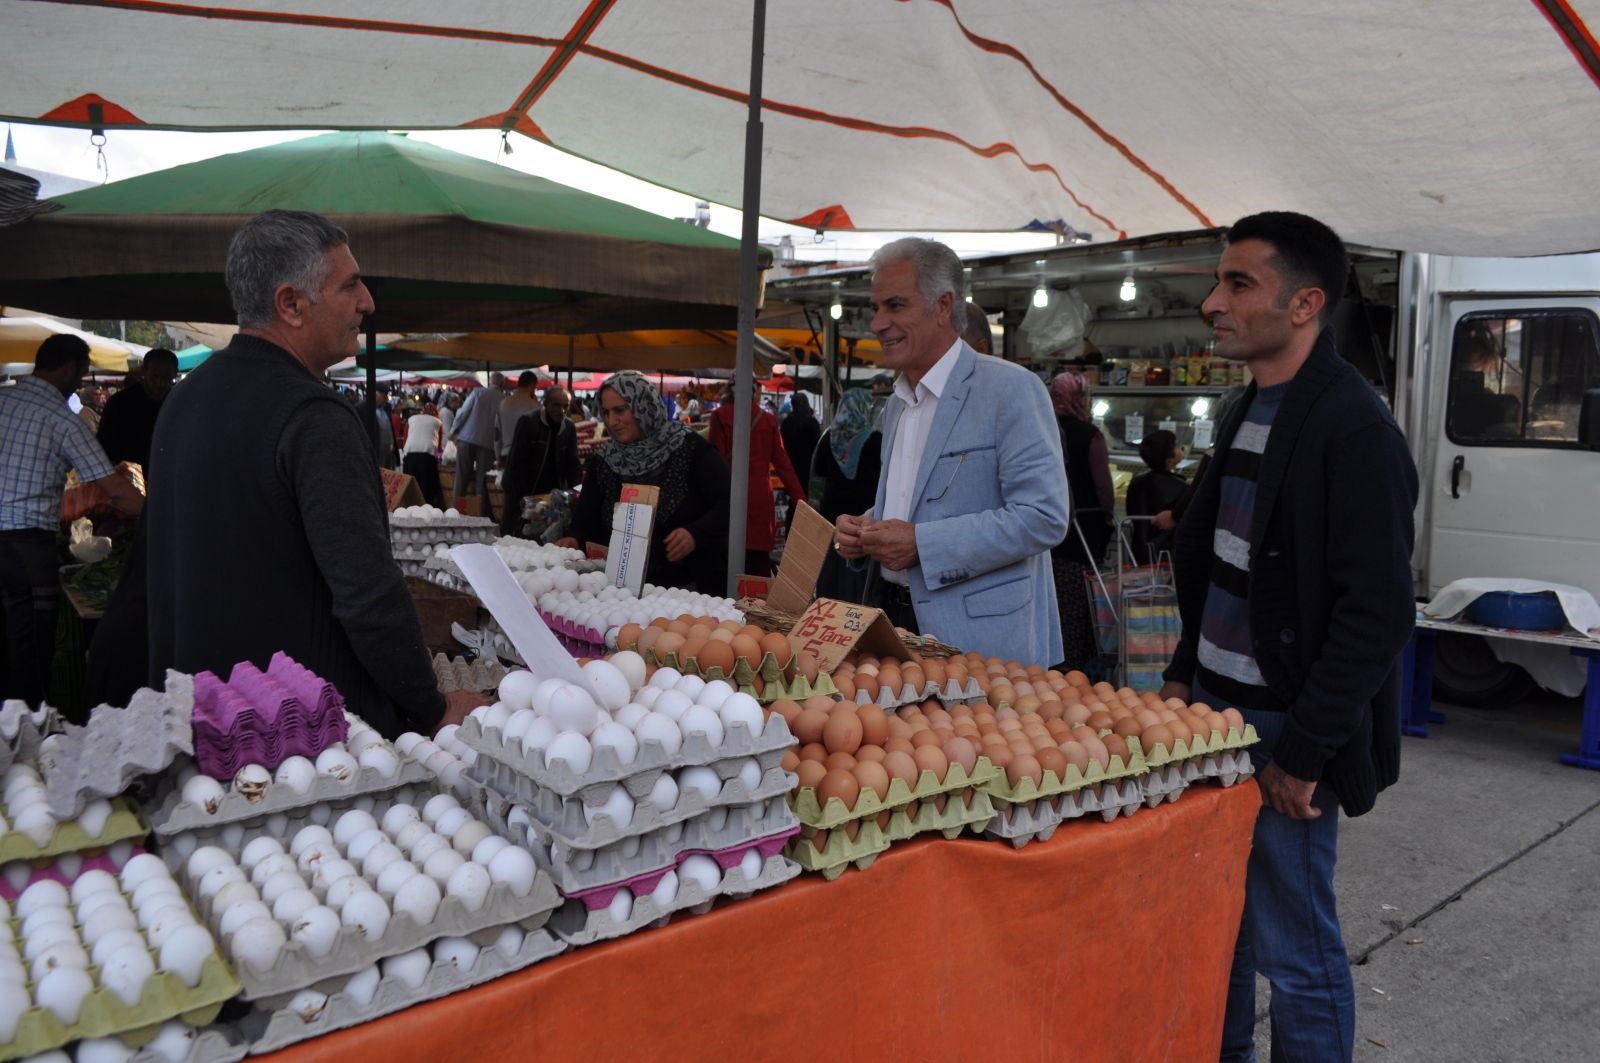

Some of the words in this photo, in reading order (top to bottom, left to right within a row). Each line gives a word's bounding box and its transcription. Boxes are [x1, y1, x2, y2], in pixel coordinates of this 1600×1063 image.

[808, 600, 837, 619] XL
[845, 606, 863, 619] Tane
[795, 615, 825, 637] 15
[818, 625, 853, 647] Tane
